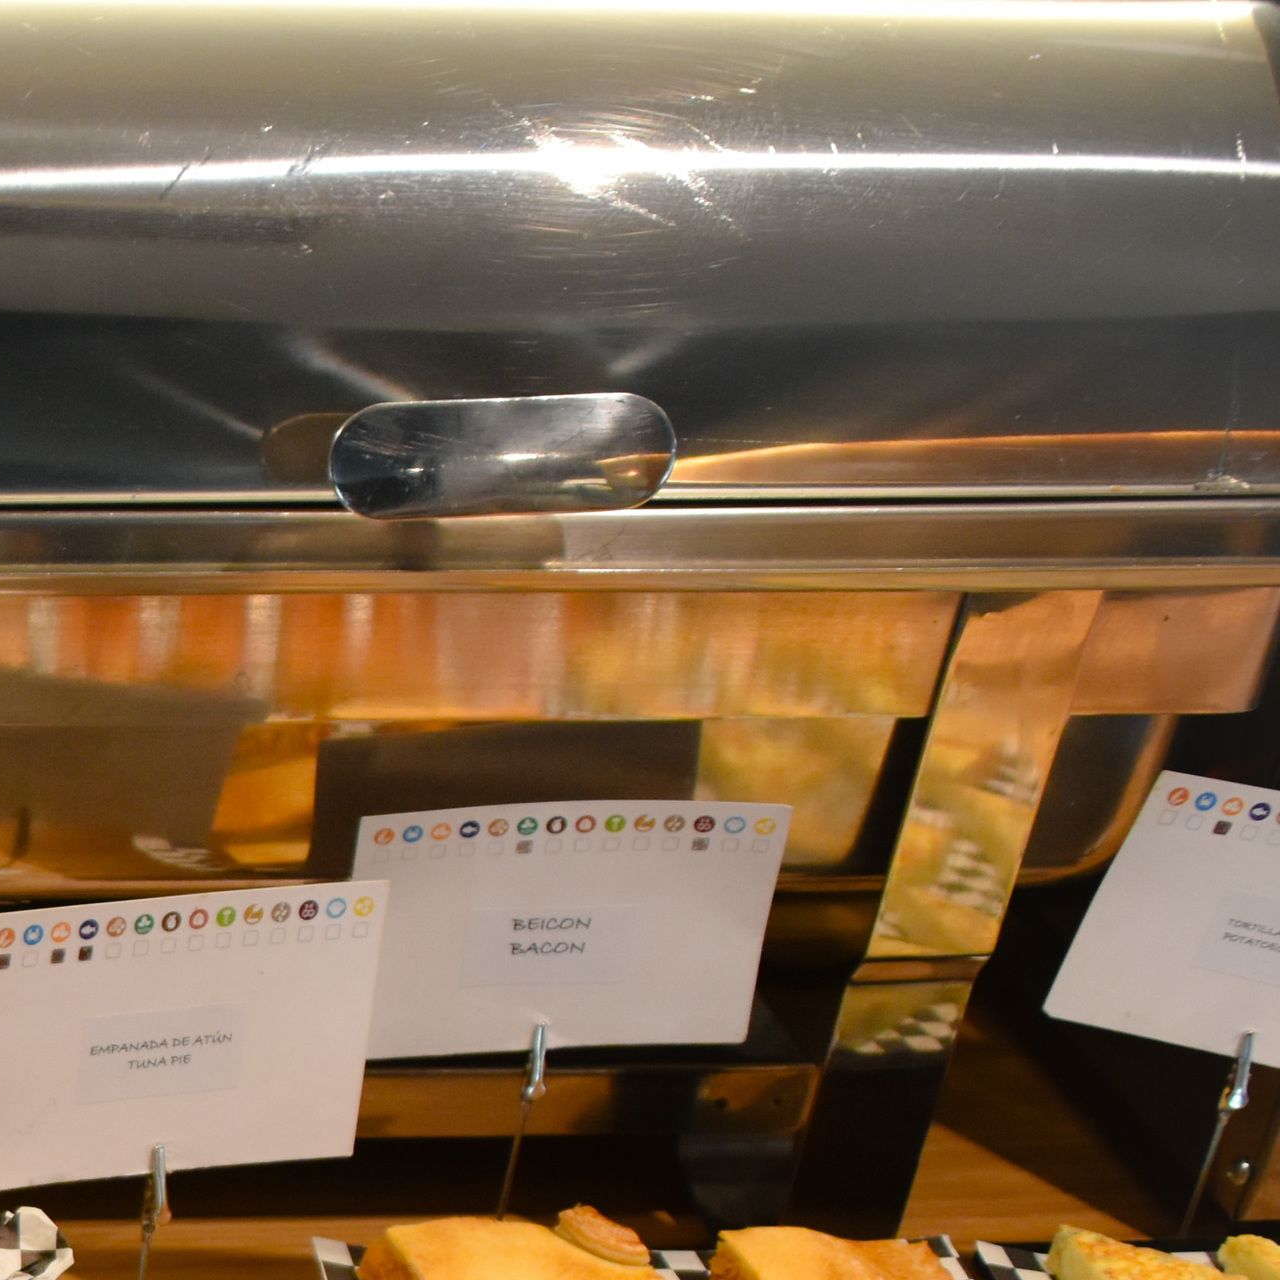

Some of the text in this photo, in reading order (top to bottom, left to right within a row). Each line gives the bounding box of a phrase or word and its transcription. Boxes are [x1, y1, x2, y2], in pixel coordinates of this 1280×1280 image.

[512, 917, 592, 931] BEICON
[510, 941, 587, 956] BACON
[90, 1030, 233, 1057] EMPANADA DE ATÚN
[128, 1054, 192, 1070] TUNA PIE
